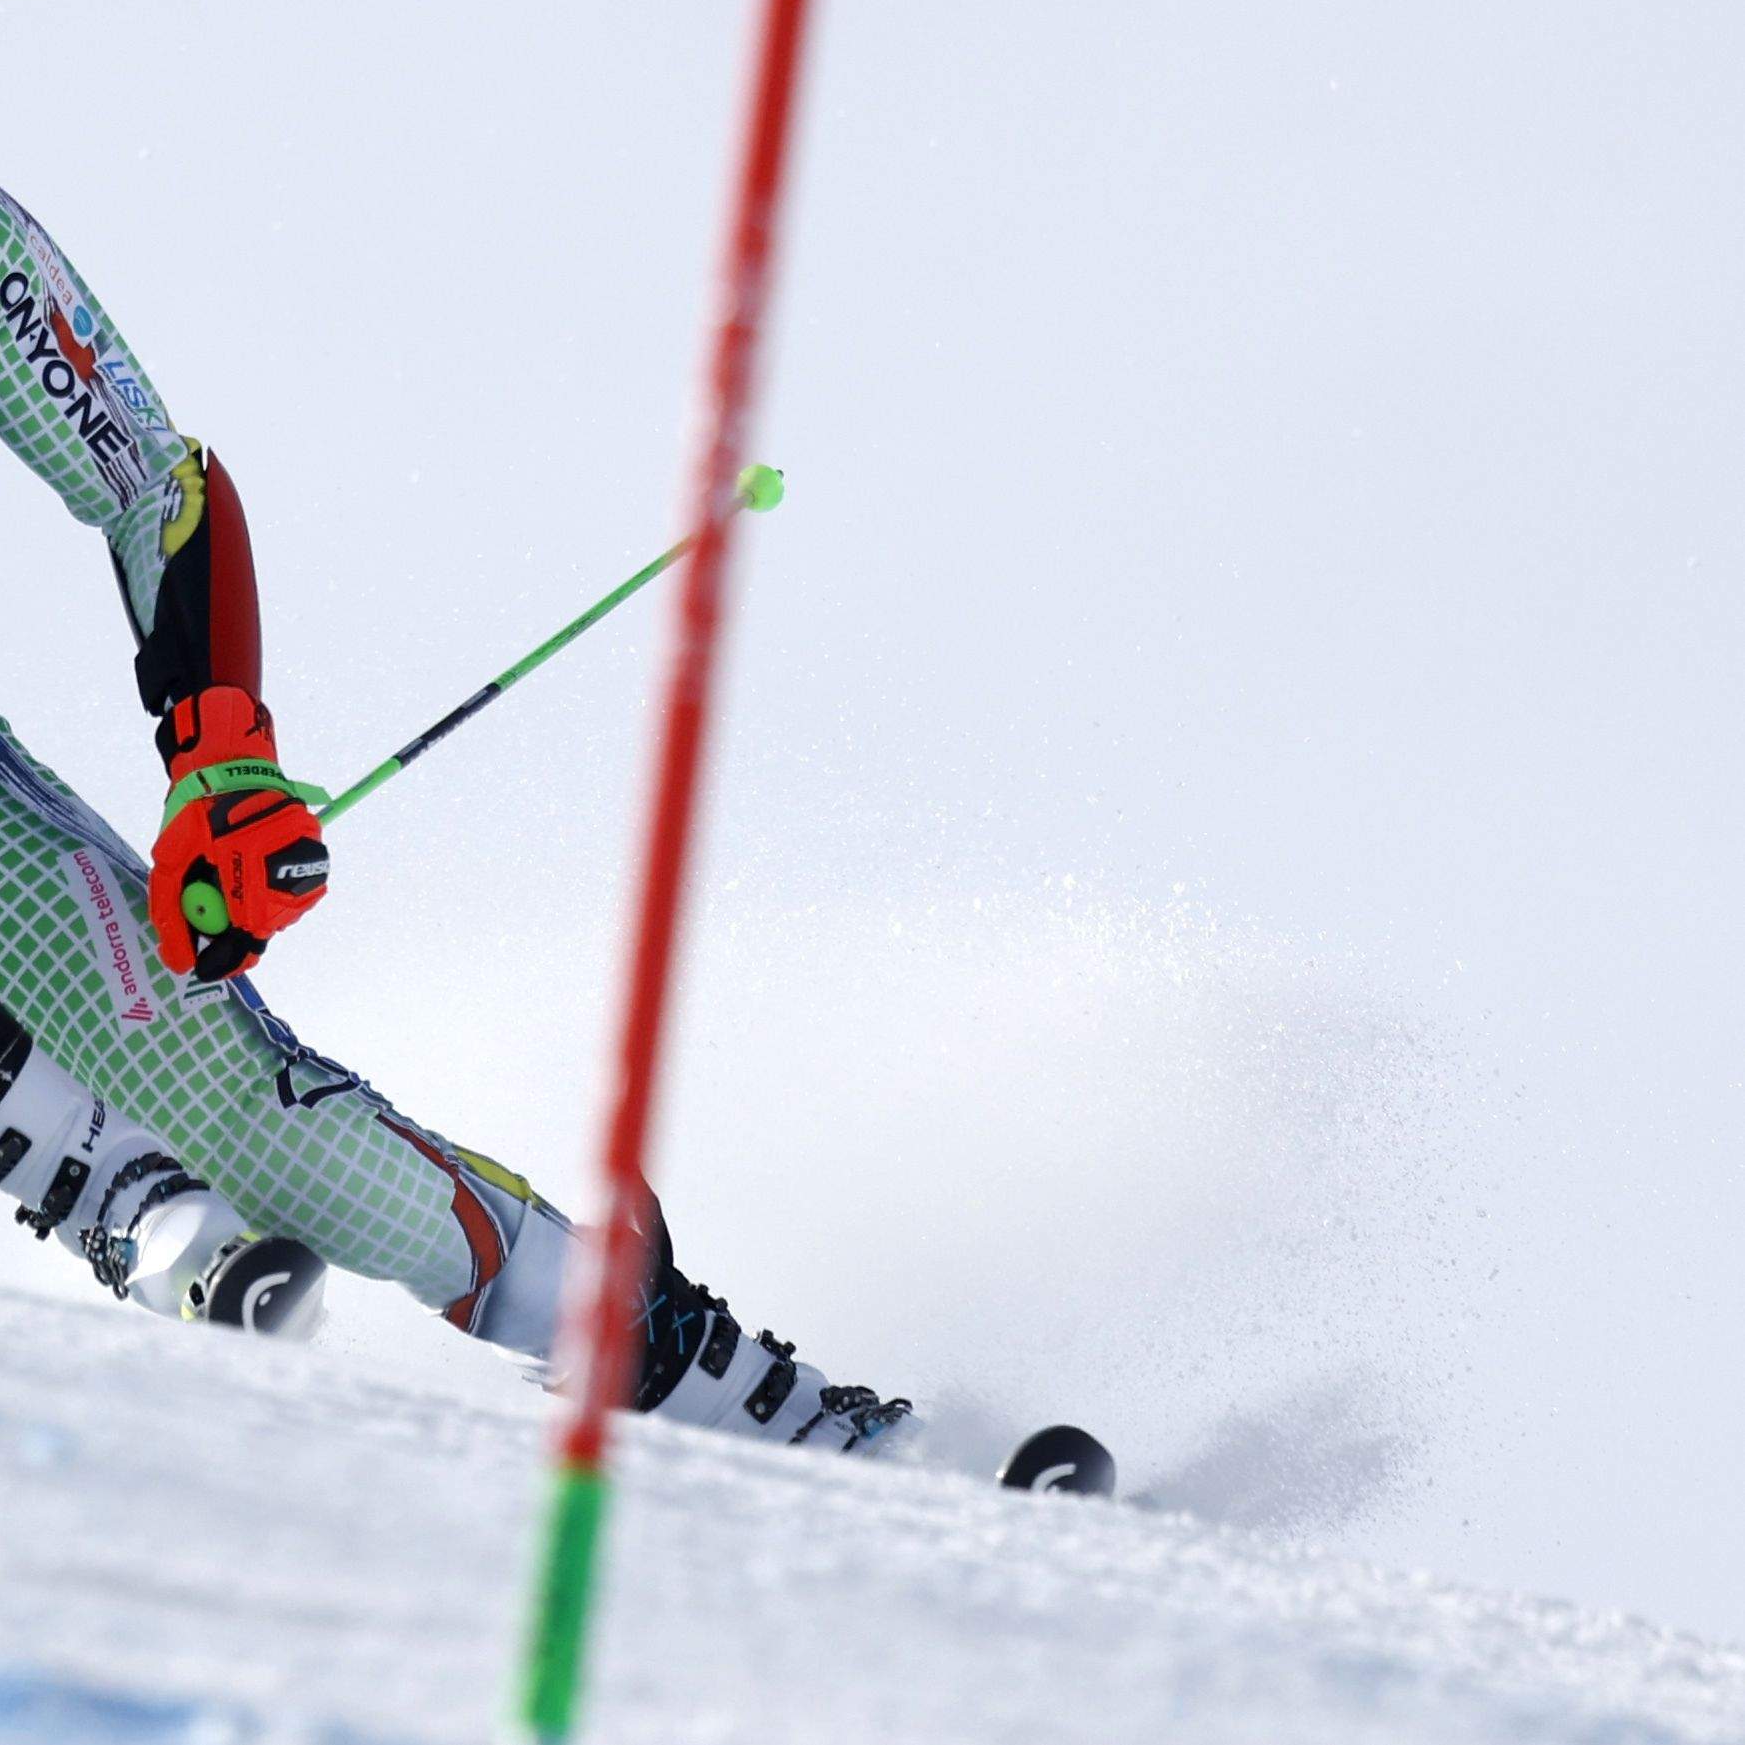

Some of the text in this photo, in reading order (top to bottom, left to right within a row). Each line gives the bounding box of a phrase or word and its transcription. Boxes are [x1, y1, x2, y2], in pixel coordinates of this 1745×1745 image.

[29, 235, 73, 305] caldea
[74, 849, 138, 996] andorra telecom
[82, 1098, 106, 1154] HEA
